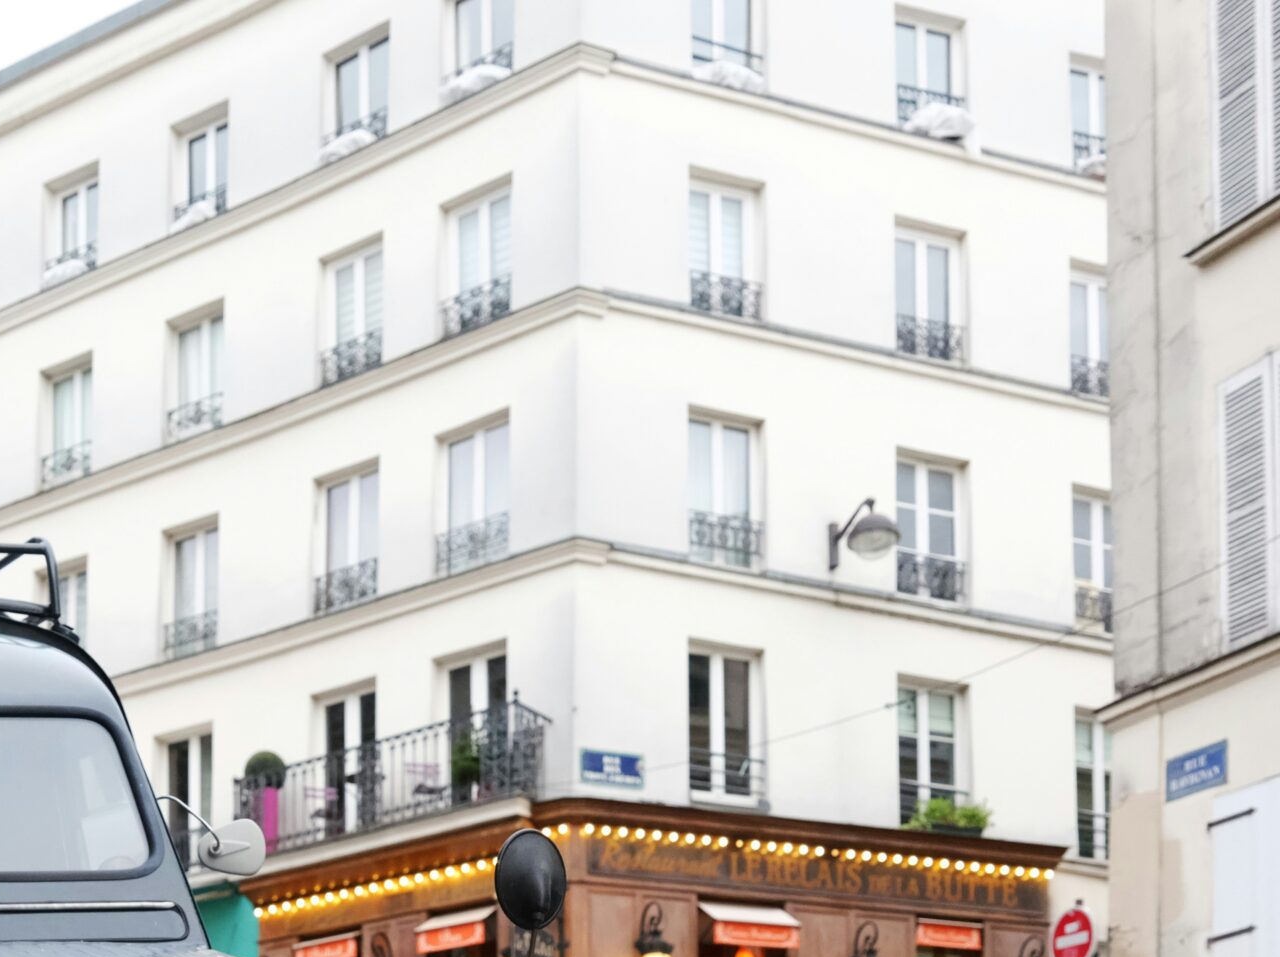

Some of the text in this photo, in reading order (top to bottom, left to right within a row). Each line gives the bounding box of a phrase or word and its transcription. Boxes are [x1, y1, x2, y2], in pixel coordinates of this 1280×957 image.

[730, 851, 763, 883] LE
[766, 854, 863, 896] RELAIS
[895, 876, 920, 897] LA
[926, 870, 1019, 909] BUTTE
